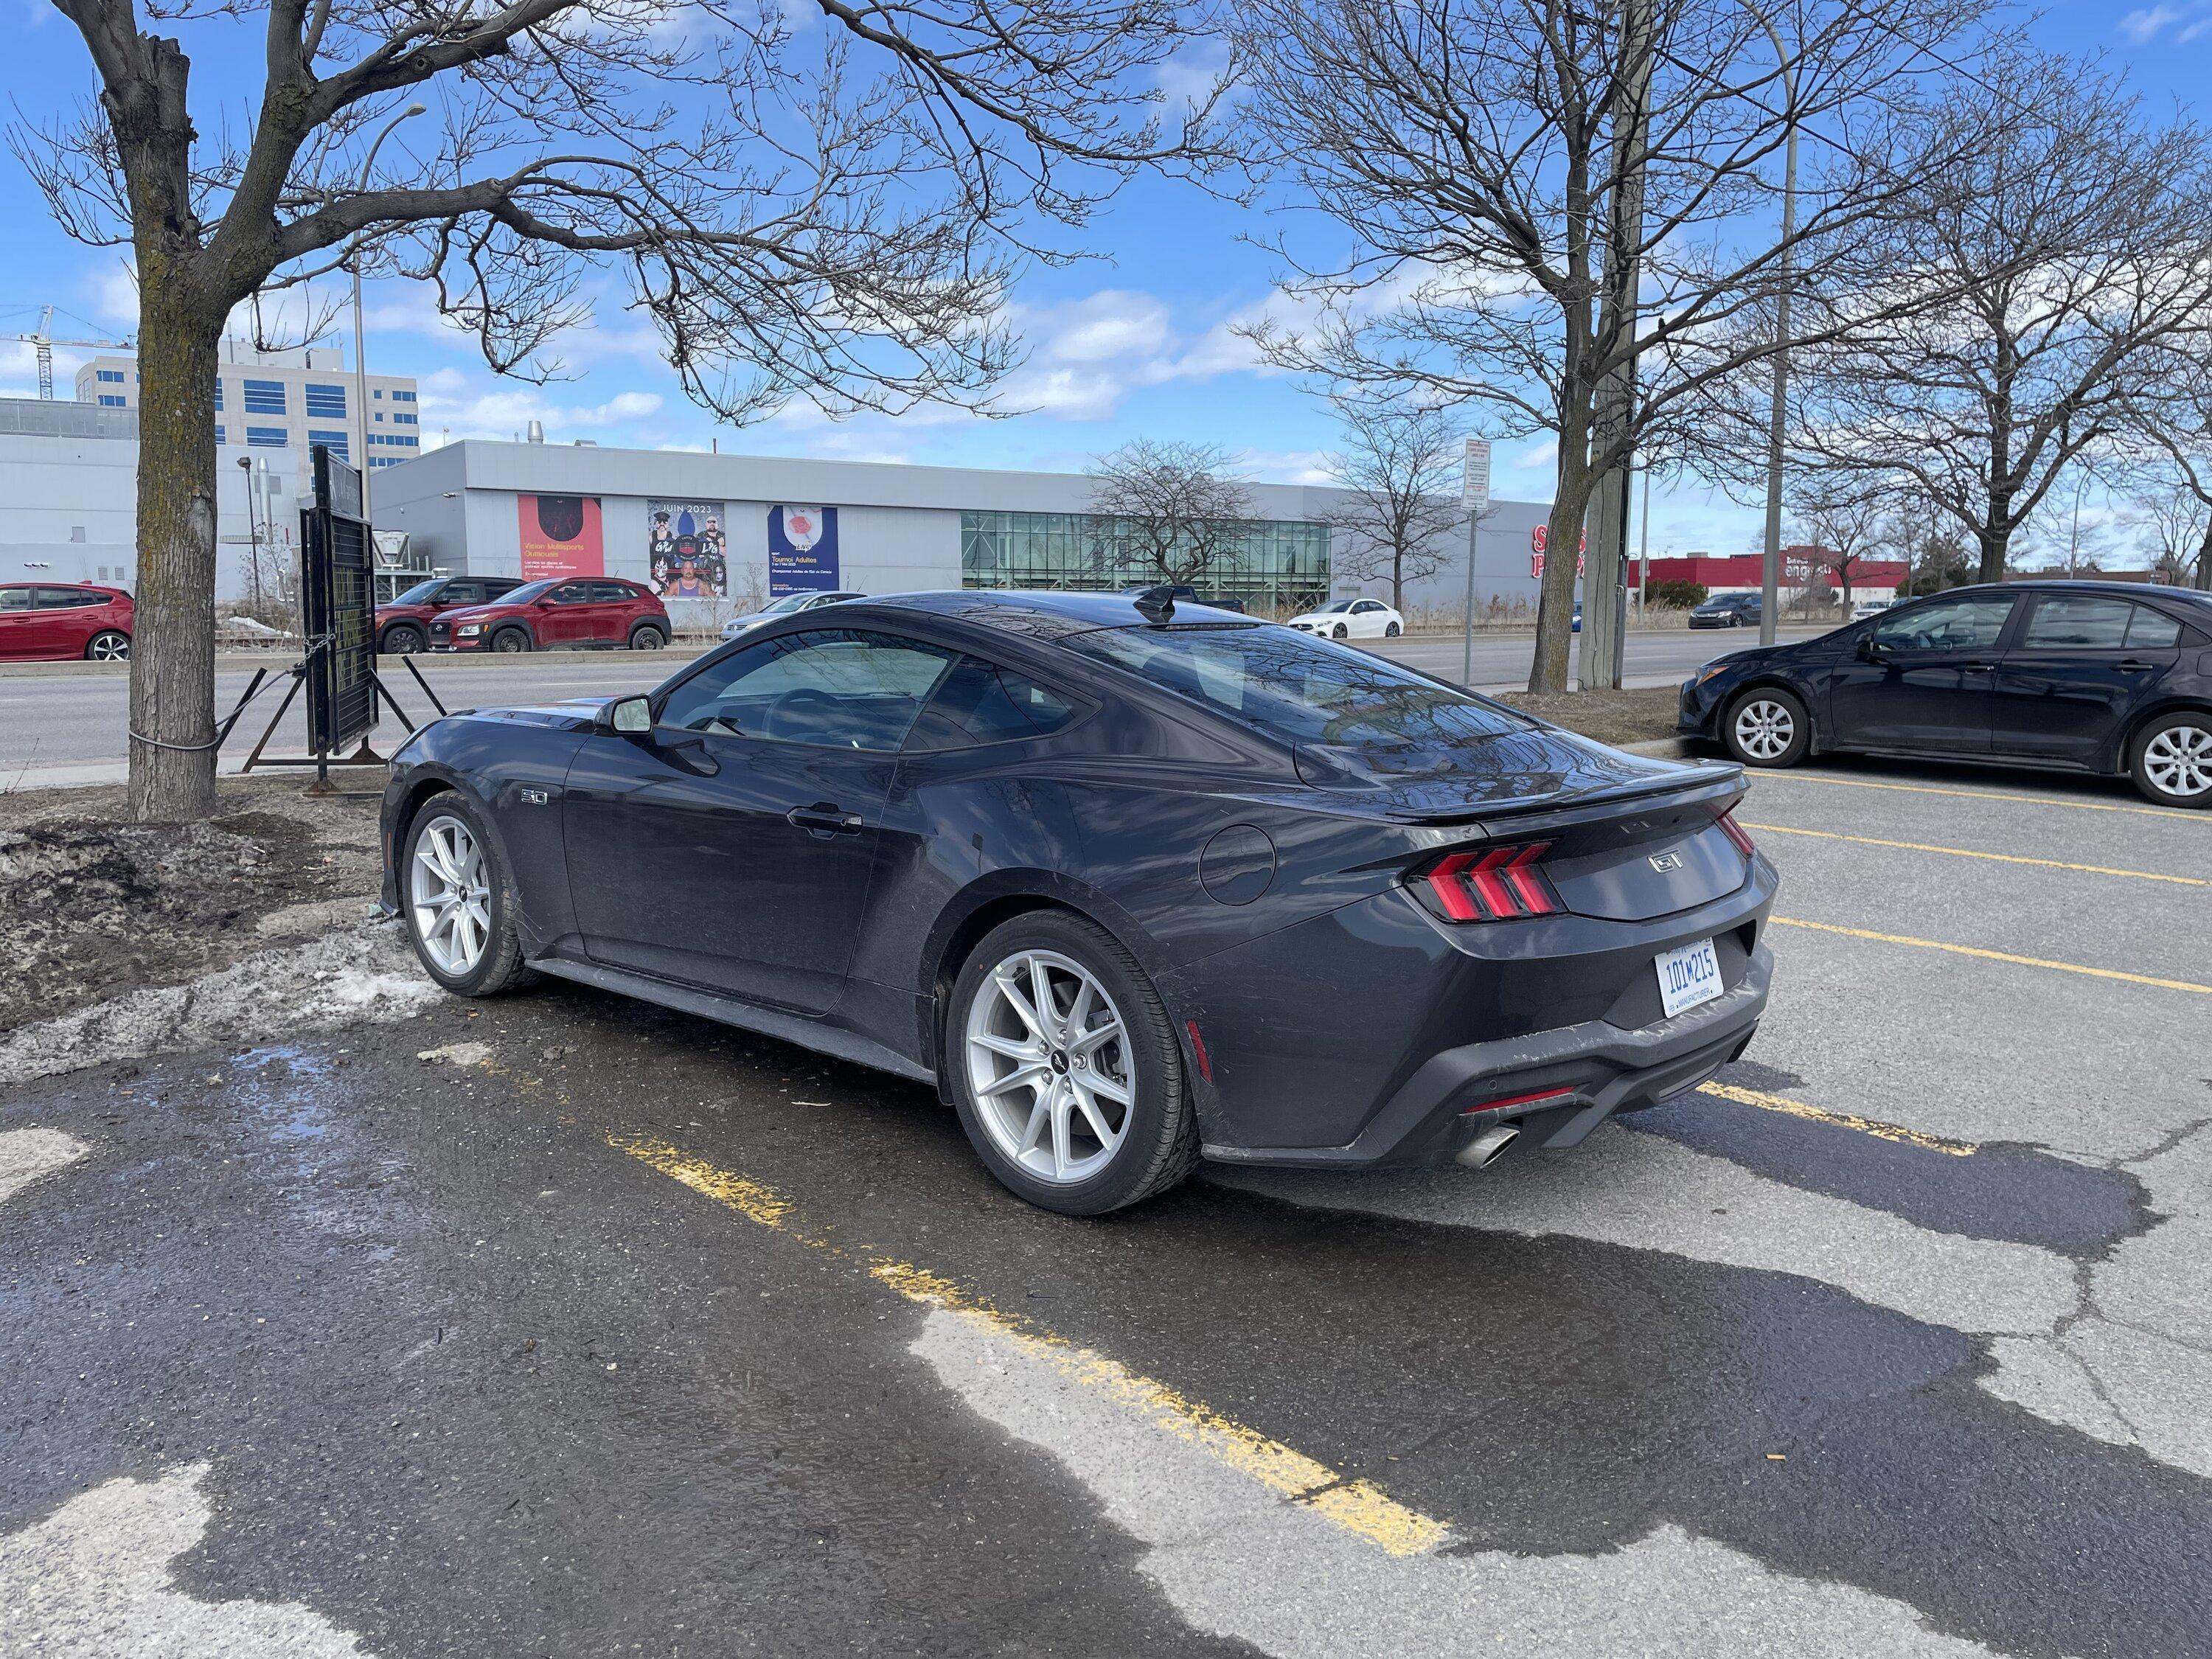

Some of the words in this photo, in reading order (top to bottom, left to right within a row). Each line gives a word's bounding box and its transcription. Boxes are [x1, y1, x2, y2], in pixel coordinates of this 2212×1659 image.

[661, 504, 684, 512] JUIN
[686, 505, 712, 513] 2023
[702, 542, 718, 554] LPG
[1647, 849, 1683, 874] GT
[1666, 947, 1714, 994] 101M215
[1678, 987, 1710, 1007] MANUFACTURER
